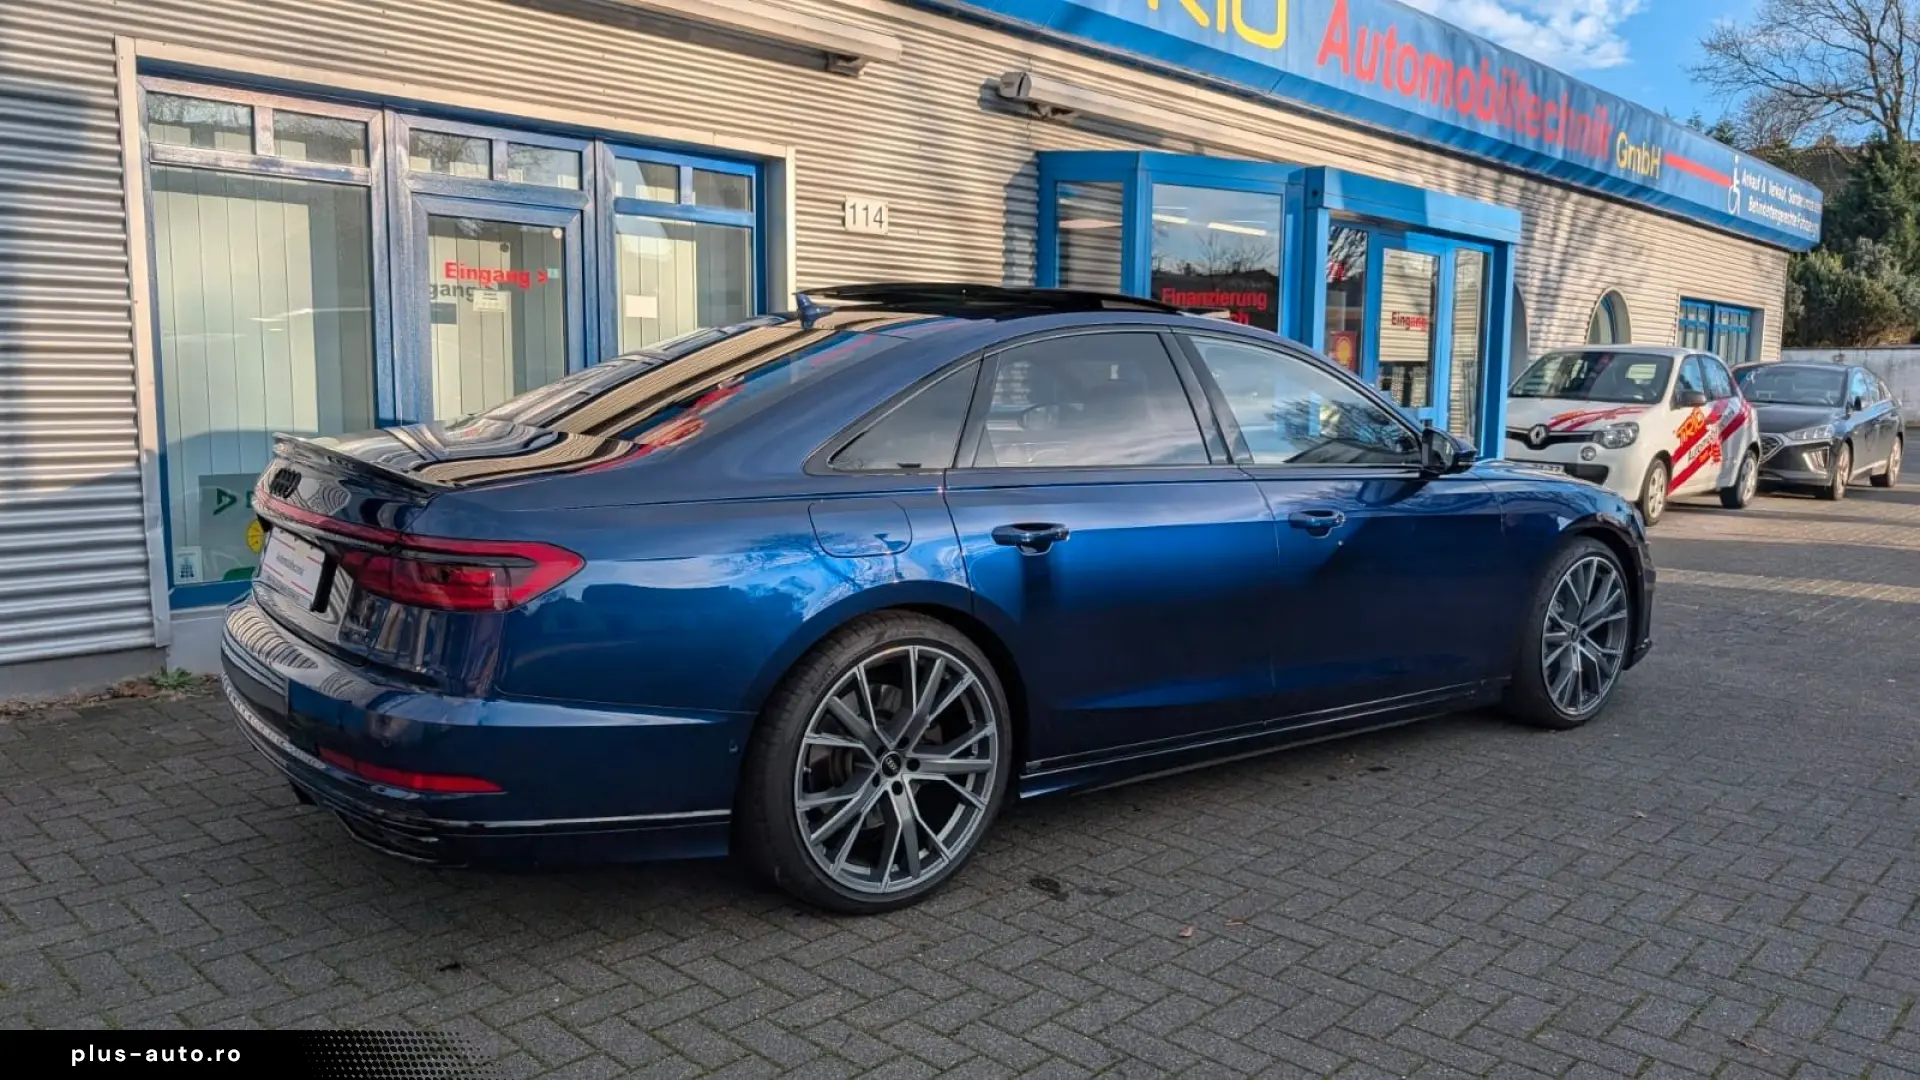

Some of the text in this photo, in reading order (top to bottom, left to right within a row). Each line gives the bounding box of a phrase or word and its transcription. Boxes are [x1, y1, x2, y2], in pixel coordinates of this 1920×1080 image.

[1317, 0, 1613, 160] Automobiltechnik
[1616, 131, 1661, 180] GmbH
[849, 202, 884, 229] 114
[445, 262, 531, 290] Eingang
[1162, 287, 1267, 311] Finanzierung
[1392, 311, 1428, 333] Eingang
